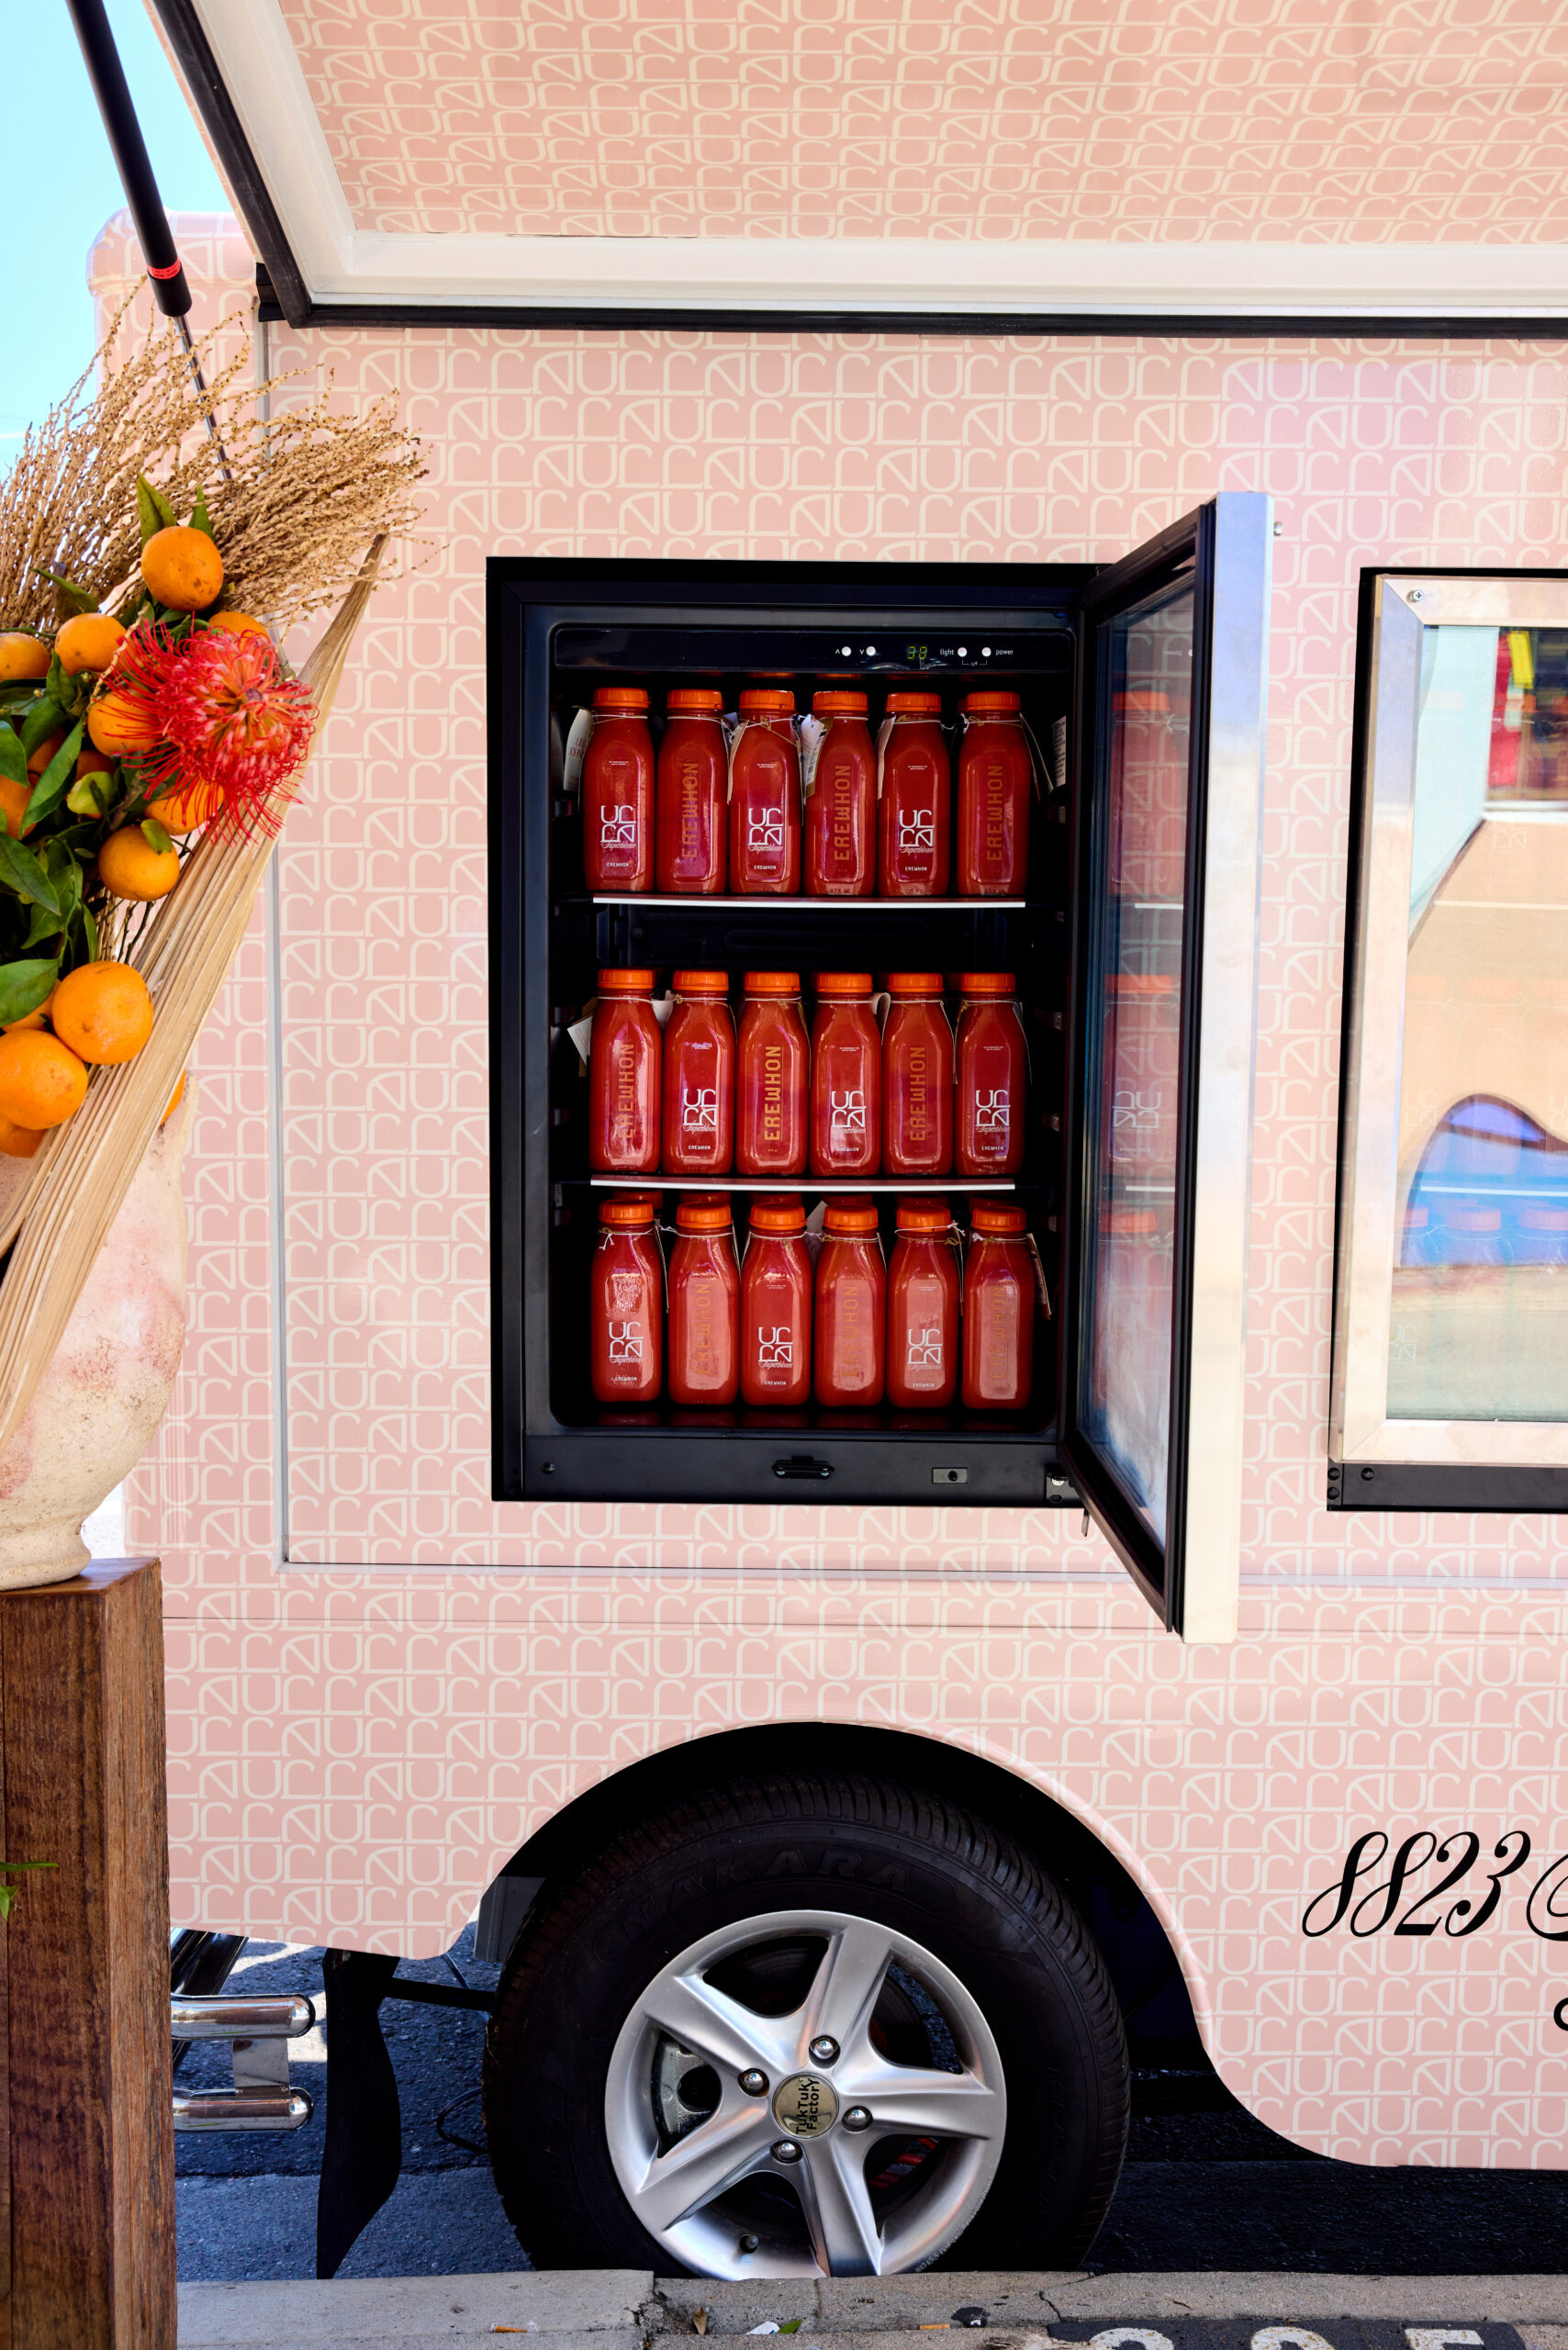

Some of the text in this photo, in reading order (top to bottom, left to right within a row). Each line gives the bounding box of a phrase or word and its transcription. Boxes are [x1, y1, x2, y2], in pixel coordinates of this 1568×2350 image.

[940, 648, 955, 656] light
[682, 763, 698, 858] EREWHON
[834, 765, 850, 861] EREWHON
[987, 765, 1003, 861] EREWHON
[618, 1044, 634, 1138] EREWHON
[765, 1046, 780, 1141] EREWHON
[910, 1046, 925, 1141] EREWHON
[696, 1283, 711, 1374] EREWHON
[991, 1286, 1006, 1379] EREWHON
[1302, 1830, 1531, 1938] 8823
